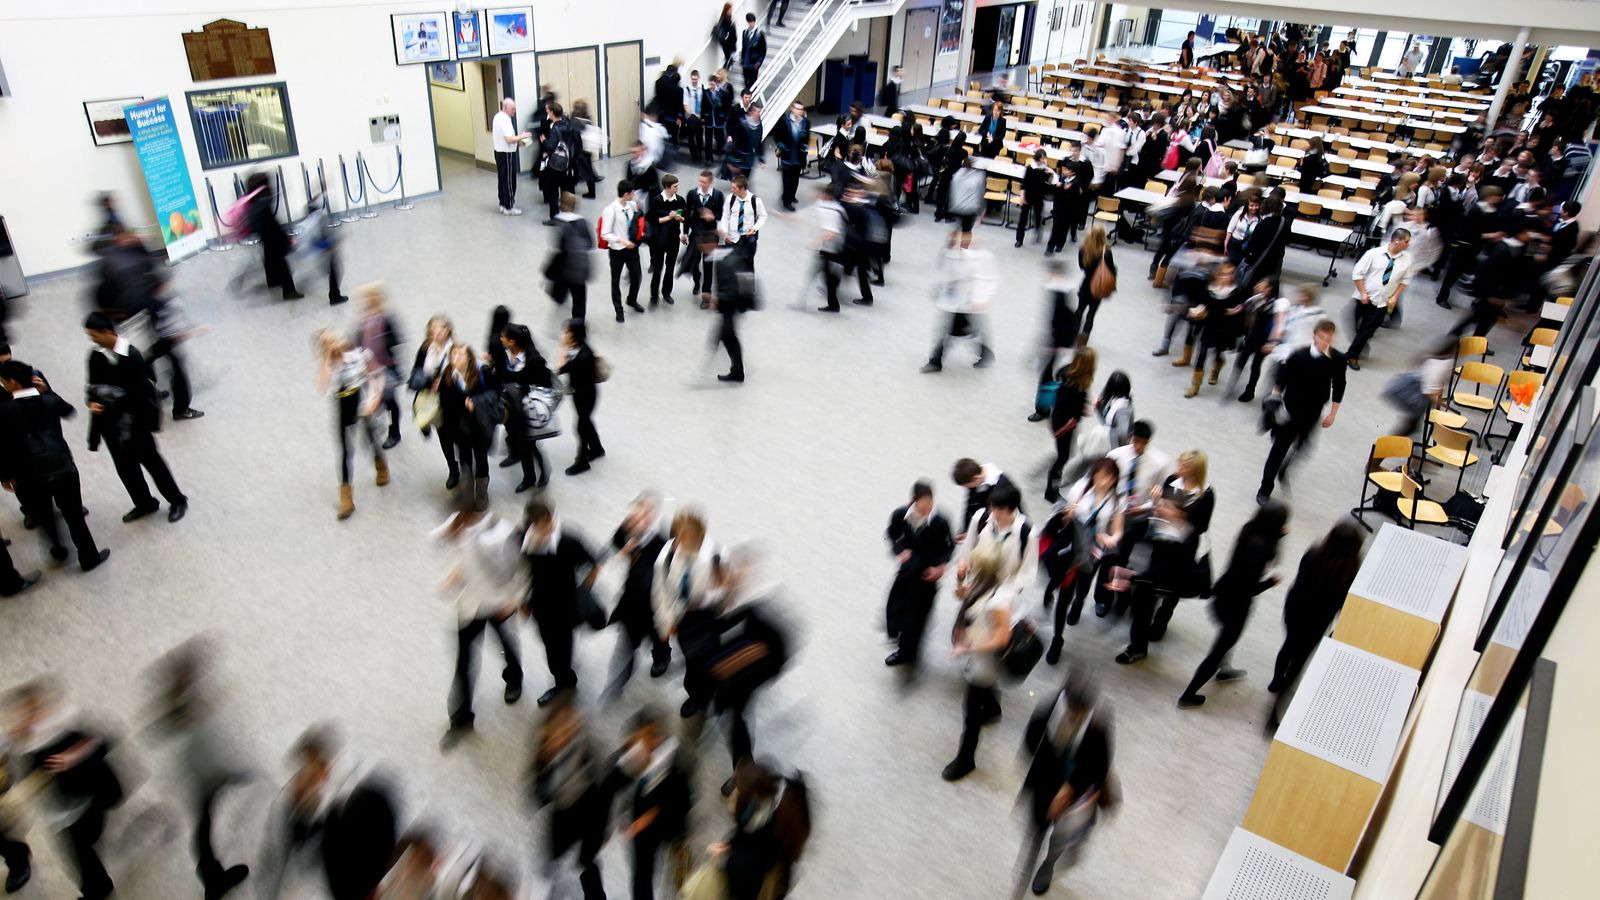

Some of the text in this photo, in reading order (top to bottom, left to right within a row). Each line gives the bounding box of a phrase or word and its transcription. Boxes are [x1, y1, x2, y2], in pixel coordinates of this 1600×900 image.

[130, 104, 166, 120] Hungry for
[137, 114, 165, 128] Success
